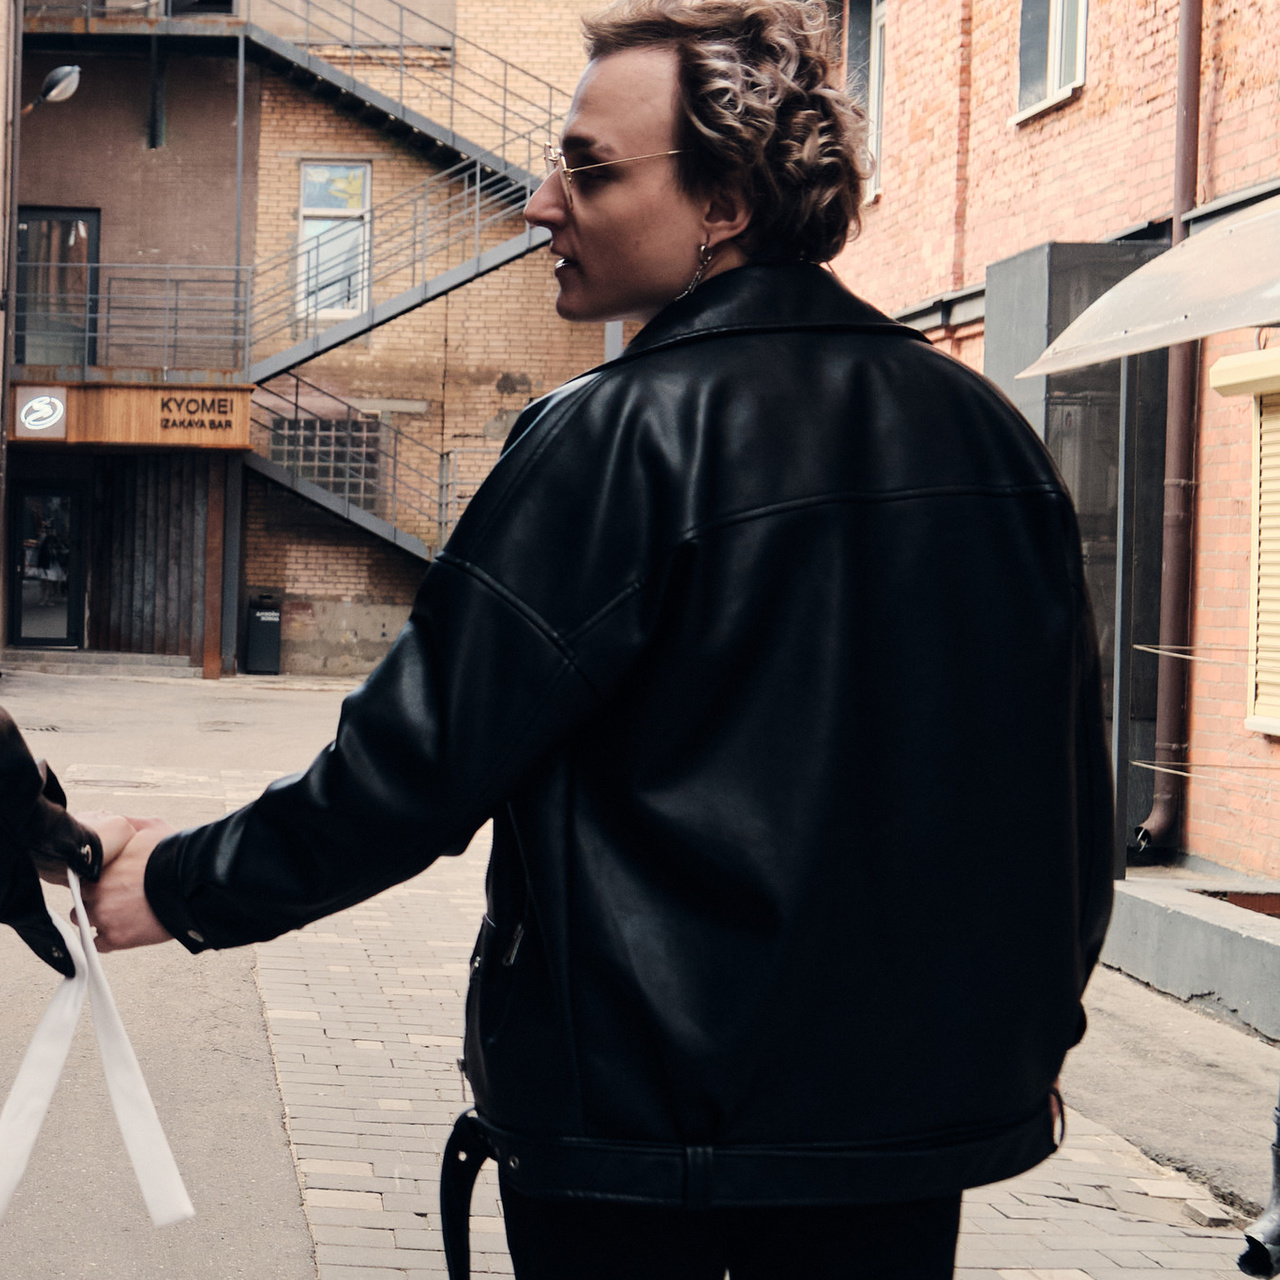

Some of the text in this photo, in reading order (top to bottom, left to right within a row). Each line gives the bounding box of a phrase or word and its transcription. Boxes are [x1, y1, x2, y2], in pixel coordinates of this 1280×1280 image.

[161, 397, 234, 415] KYOMEI
[161, 418, 233, 430] IZAKAYA BAR
